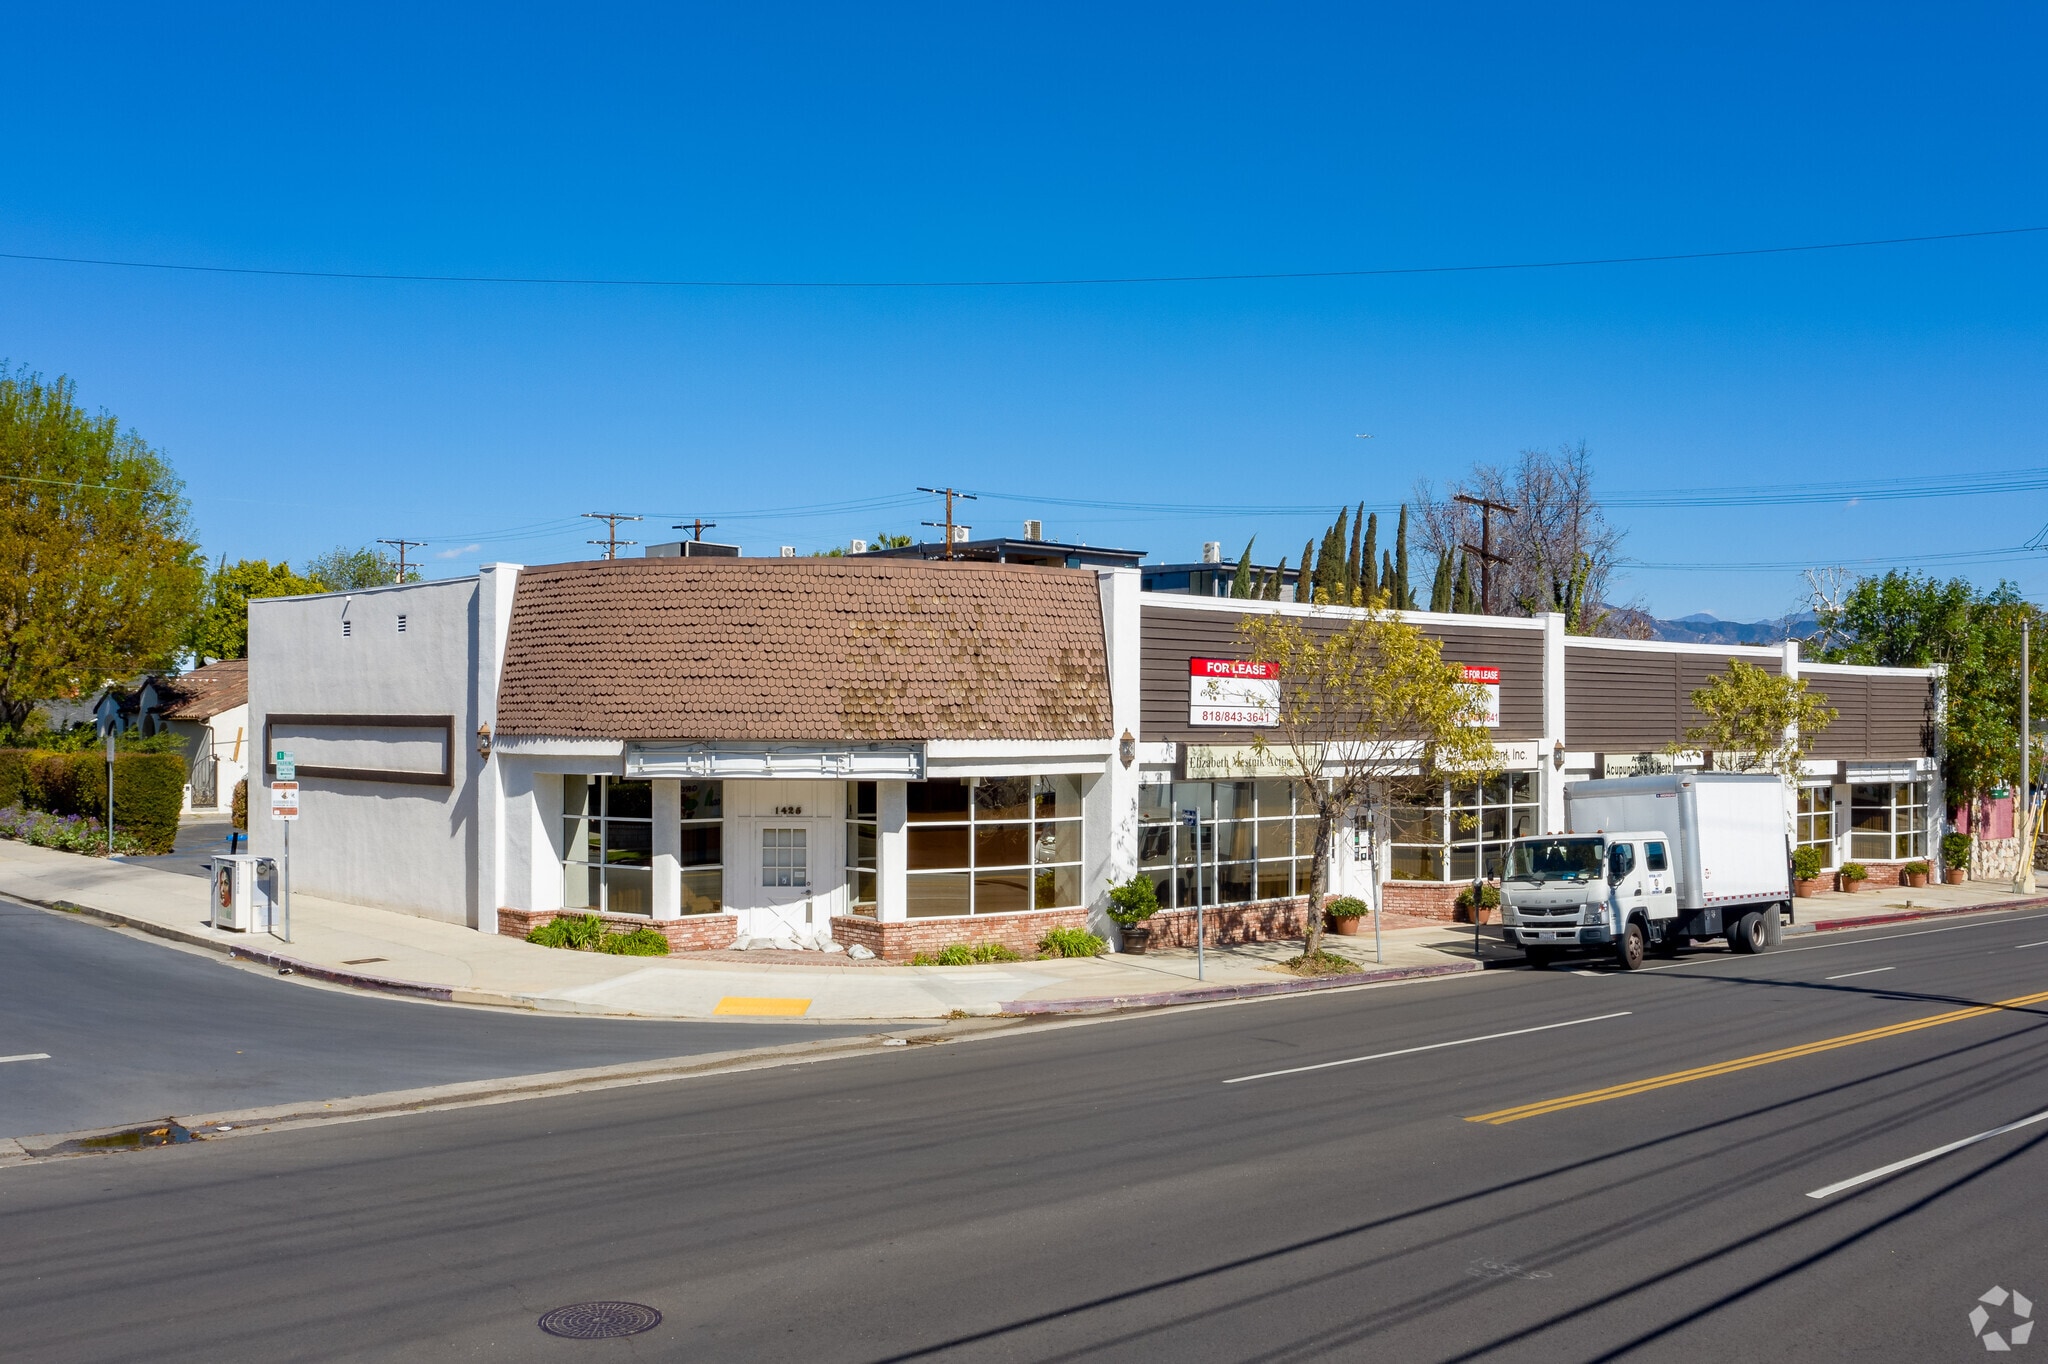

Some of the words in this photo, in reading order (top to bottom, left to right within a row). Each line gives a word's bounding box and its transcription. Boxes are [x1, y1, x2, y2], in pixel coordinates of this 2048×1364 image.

[1207, 662, 1229, 673] FOR
[1232, 664, 1266, 675] LEASE
[1469, 670, 1481, 679] FOR
[1481, 670, 1498, 680] LEASE
[1202, 711, 1270, 722] 818/843-3641
[1512, 748, 1527, 760] Inc.
[1190, 756, 1229, 769] Elizabeth
[1267, 755, 1294, 767] Actin
[1606, 762, 1648, 777] Acupuncture
[1656, 761, 1672, 775] Herb
